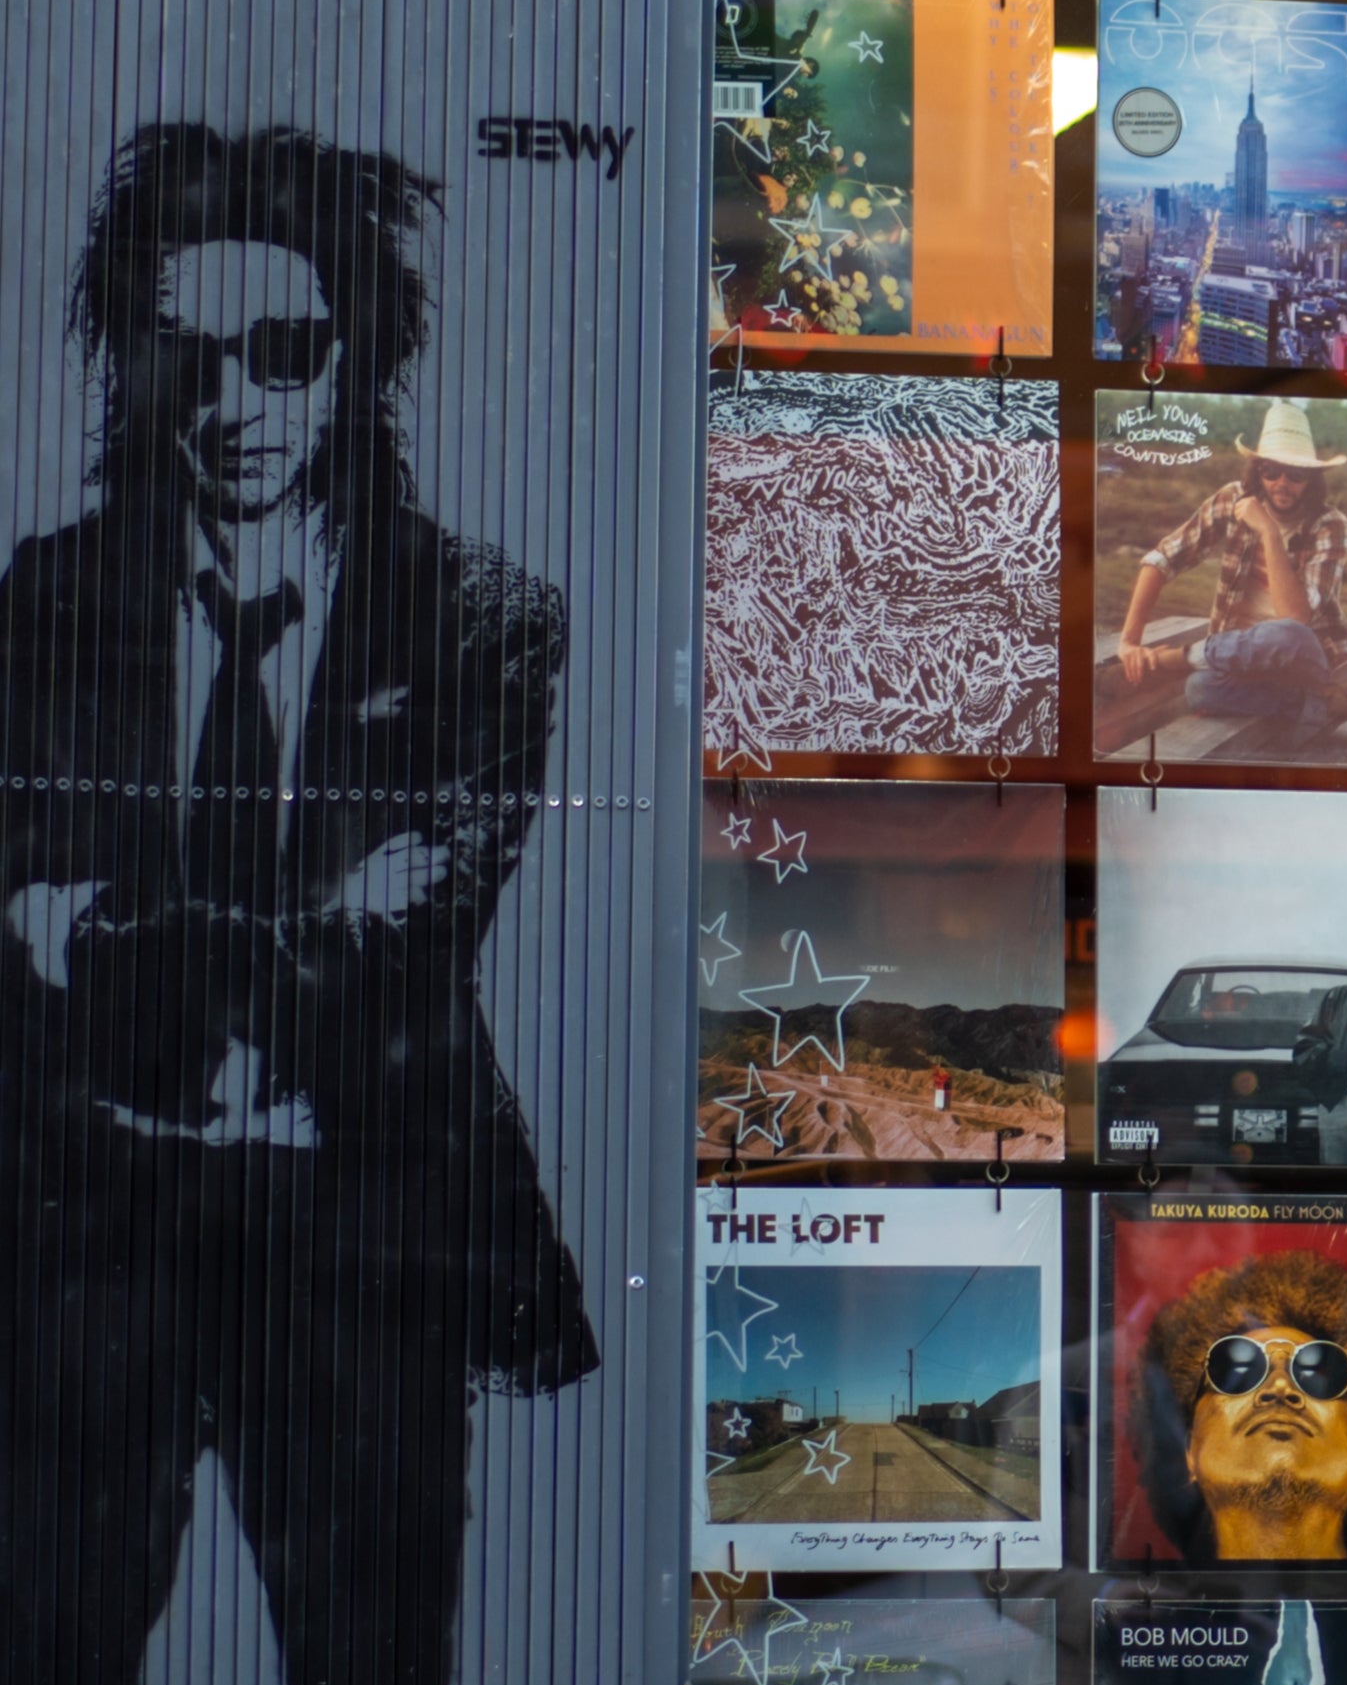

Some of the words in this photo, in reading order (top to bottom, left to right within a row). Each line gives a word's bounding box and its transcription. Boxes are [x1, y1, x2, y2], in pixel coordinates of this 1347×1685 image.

[1116, 405, 1158, 434] NEIL
[1162, 403, 1209, 435] YOUNG
[1127, 428, 1197, 446] OCEANSIDE
[1113, 442, 1213, 466] COUNTRYSIDE
[1151, 1204, 1203, 1218] TAKUYA
[1207, 1205, 1270, 1219] KURODA
[1273, 1205, 1295, 1218] FLY
[706, 1214, 777, 1244] THE
[791, 1213, 886, 1244] LOFT
[1121, 1627, 1166, 1646] BOB
[1171, 1627, 1249, 1646] MOULD
[1121, 1655, 1155, 1668] HERE
[1157, 1655, 1179, 1667] WE
[1182, 1655, 1204, 1667] GO
[1207, 1654, 1250, 1668] CRAZY
